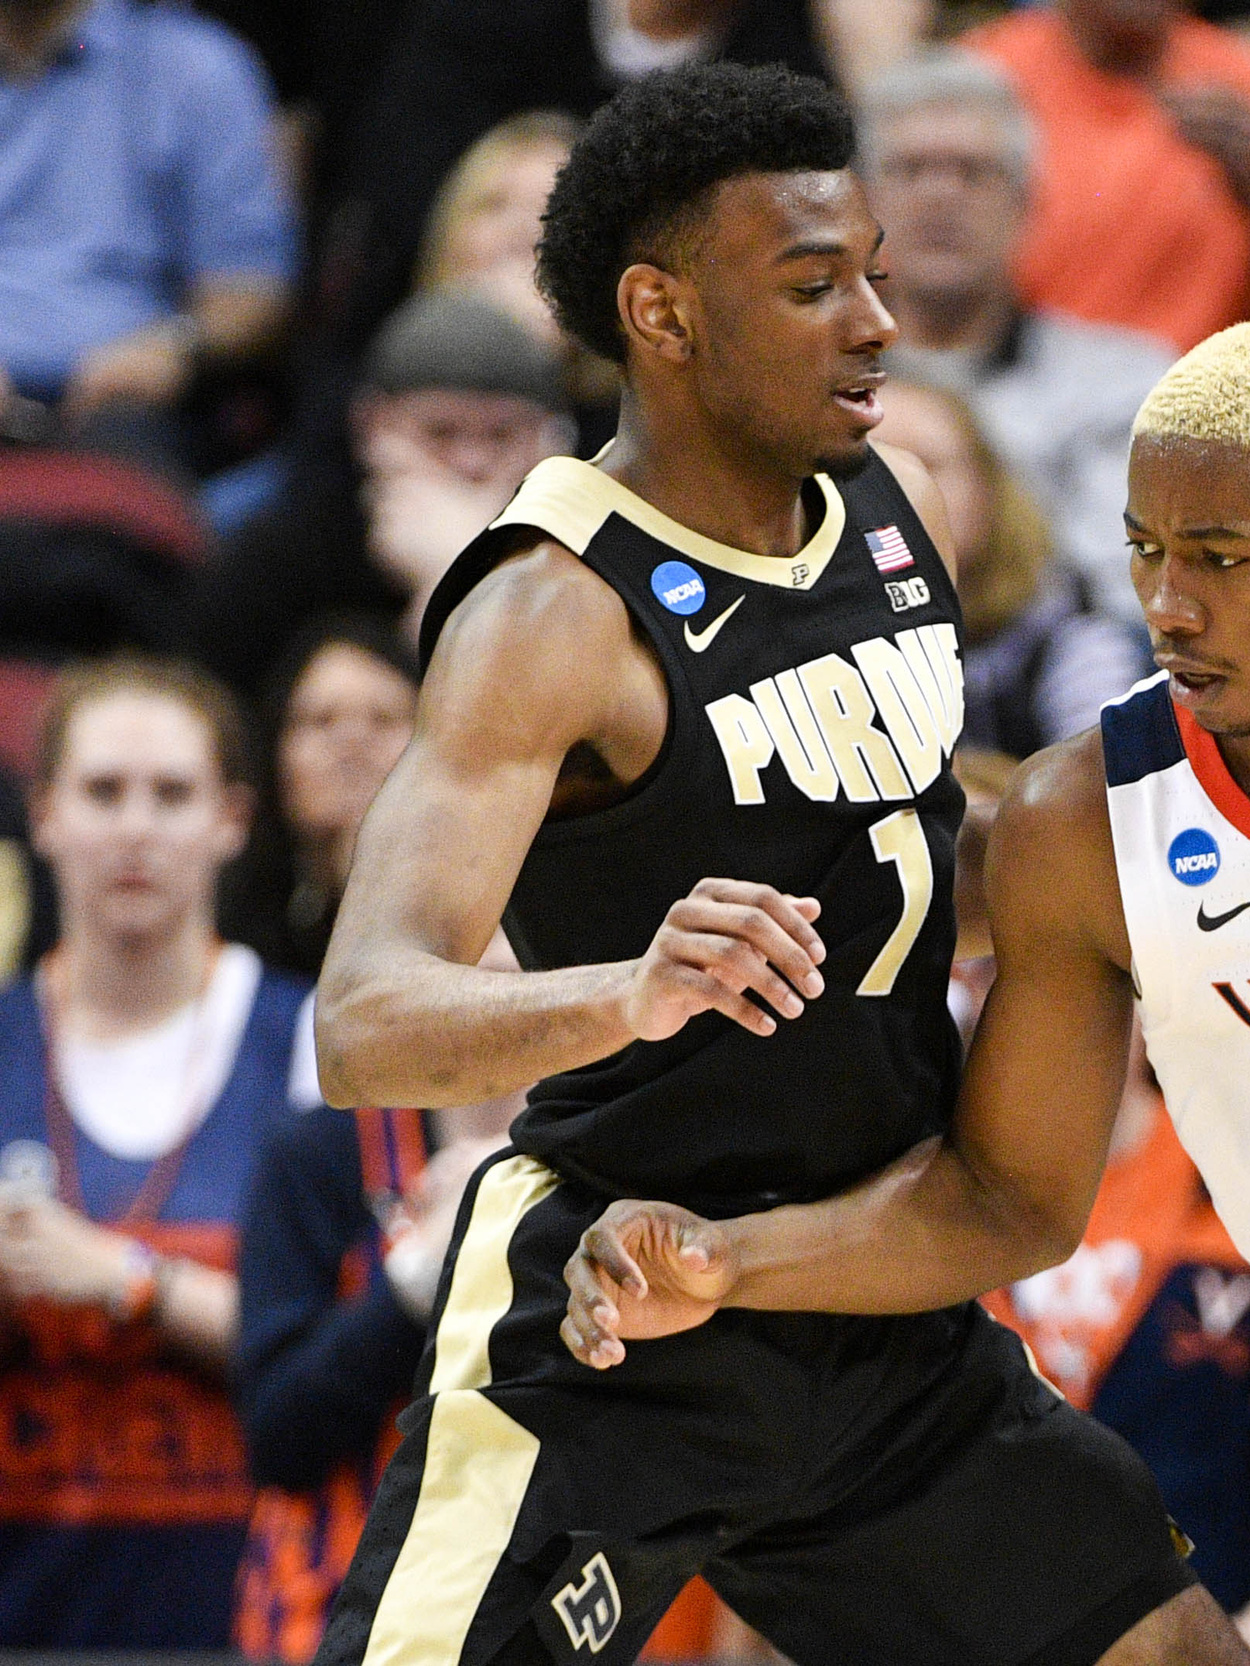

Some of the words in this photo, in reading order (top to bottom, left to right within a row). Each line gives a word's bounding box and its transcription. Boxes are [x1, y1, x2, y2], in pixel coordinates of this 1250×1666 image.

[791, 563, 810, 586] P
[663, 579, 705, 605] NCAA
[1175, 852, 1218, 874] NCAA
[856, 808, 933, 996] 1
